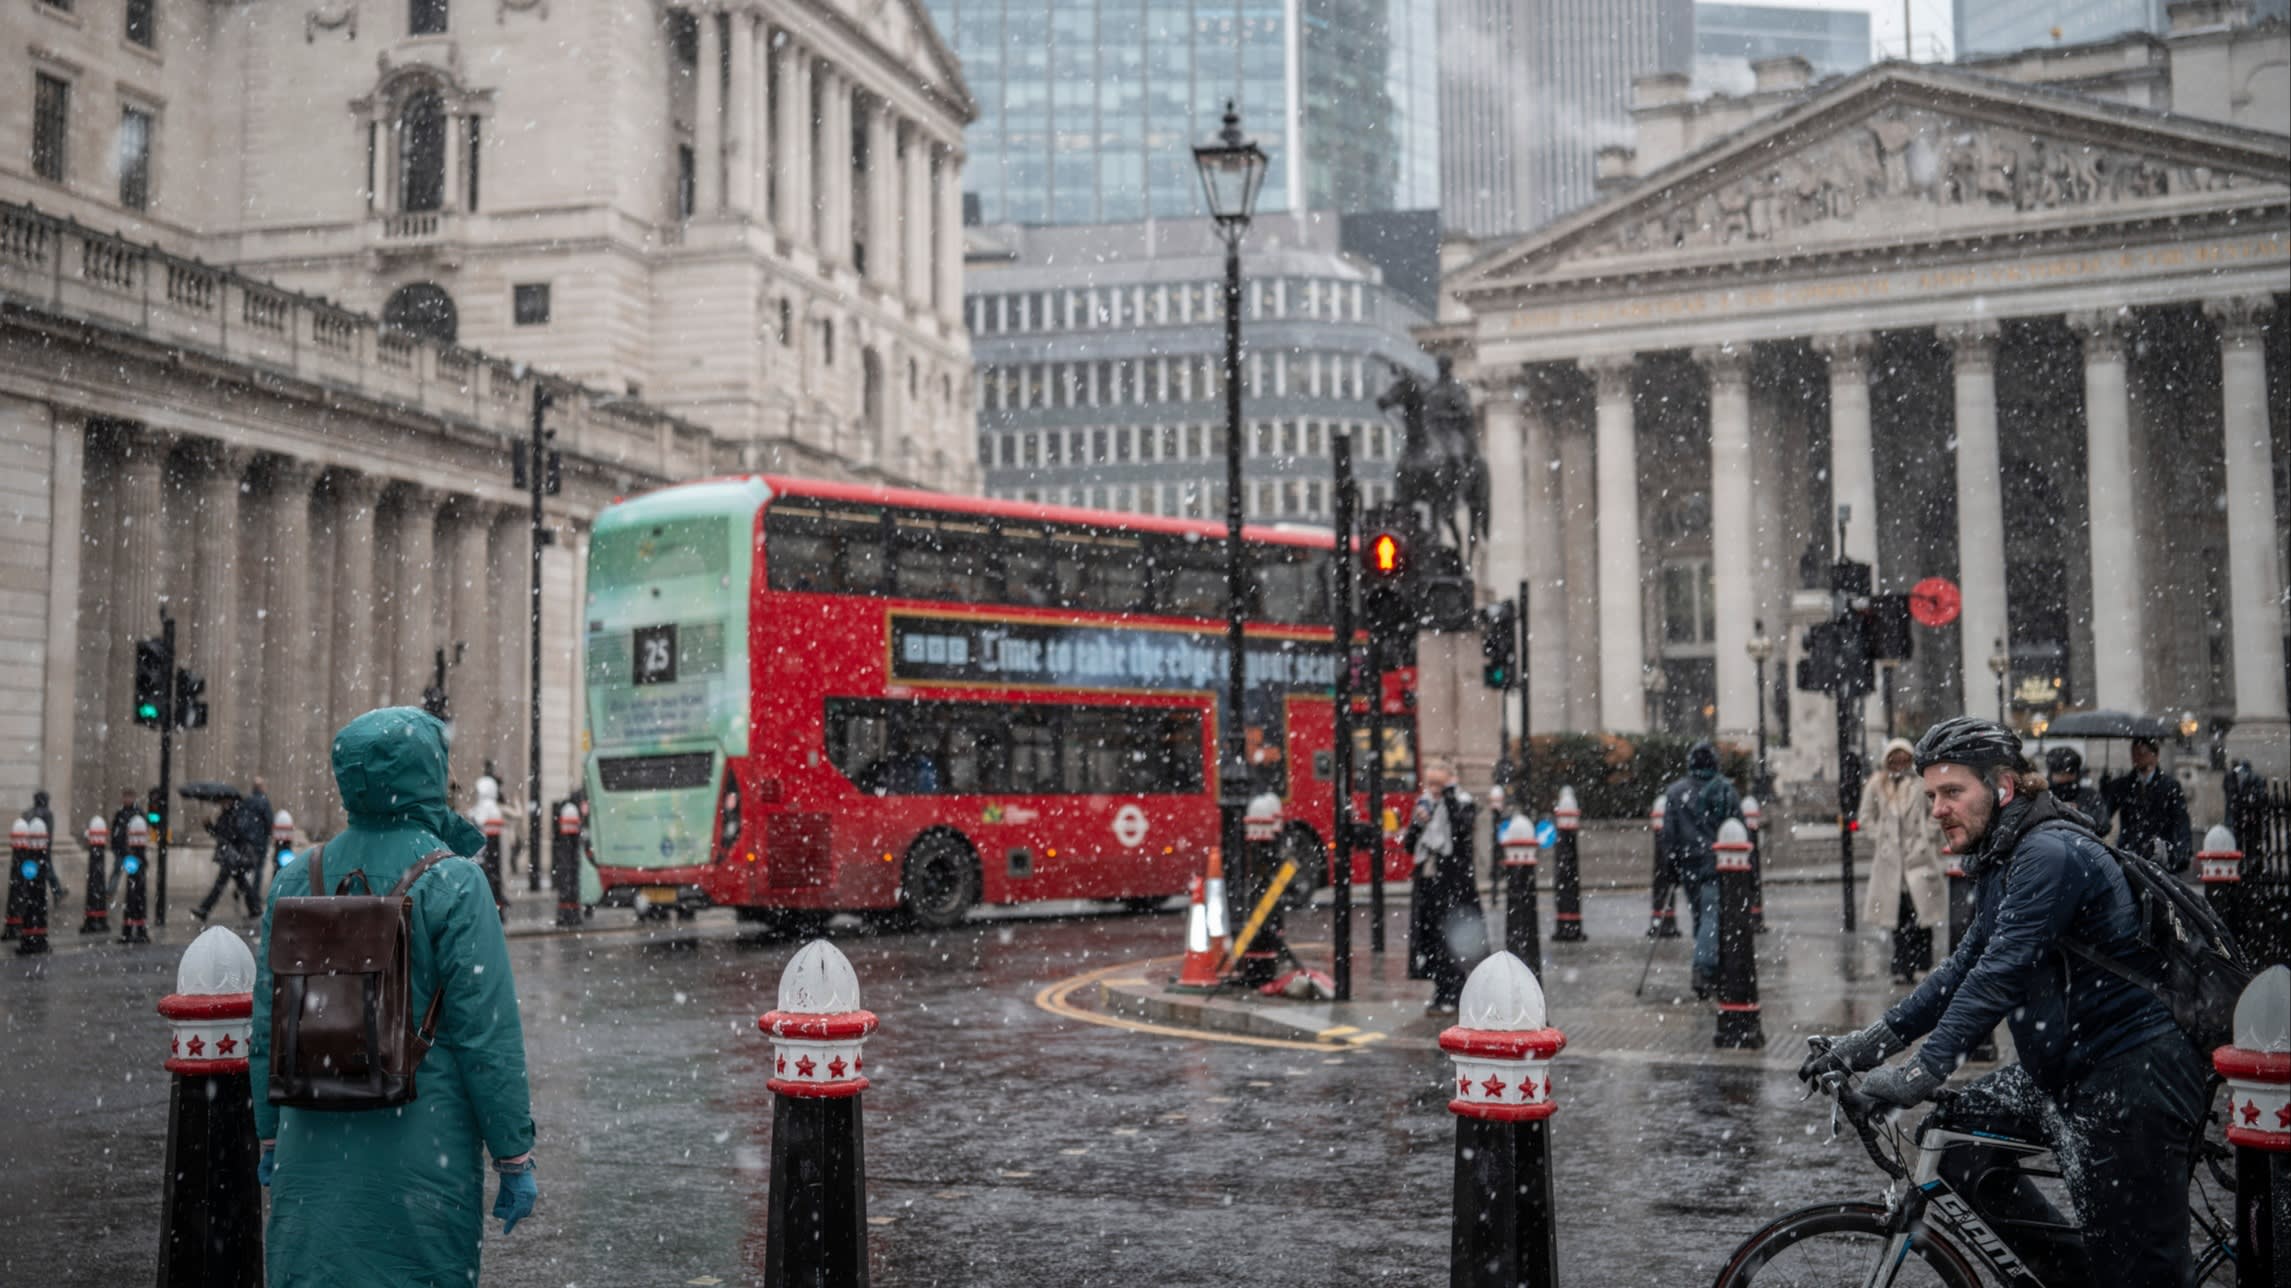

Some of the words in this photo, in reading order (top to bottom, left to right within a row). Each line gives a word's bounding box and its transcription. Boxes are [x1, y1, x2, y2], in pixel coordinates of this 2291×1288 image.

[644, 637, 670, 672] 25
[980, 628, 1041, 673] Time
[1045, 638, 1072, 674] to
[1296, 653, 1336, 684] sea
[1934, 1191, 2033, 1280] GIANT
